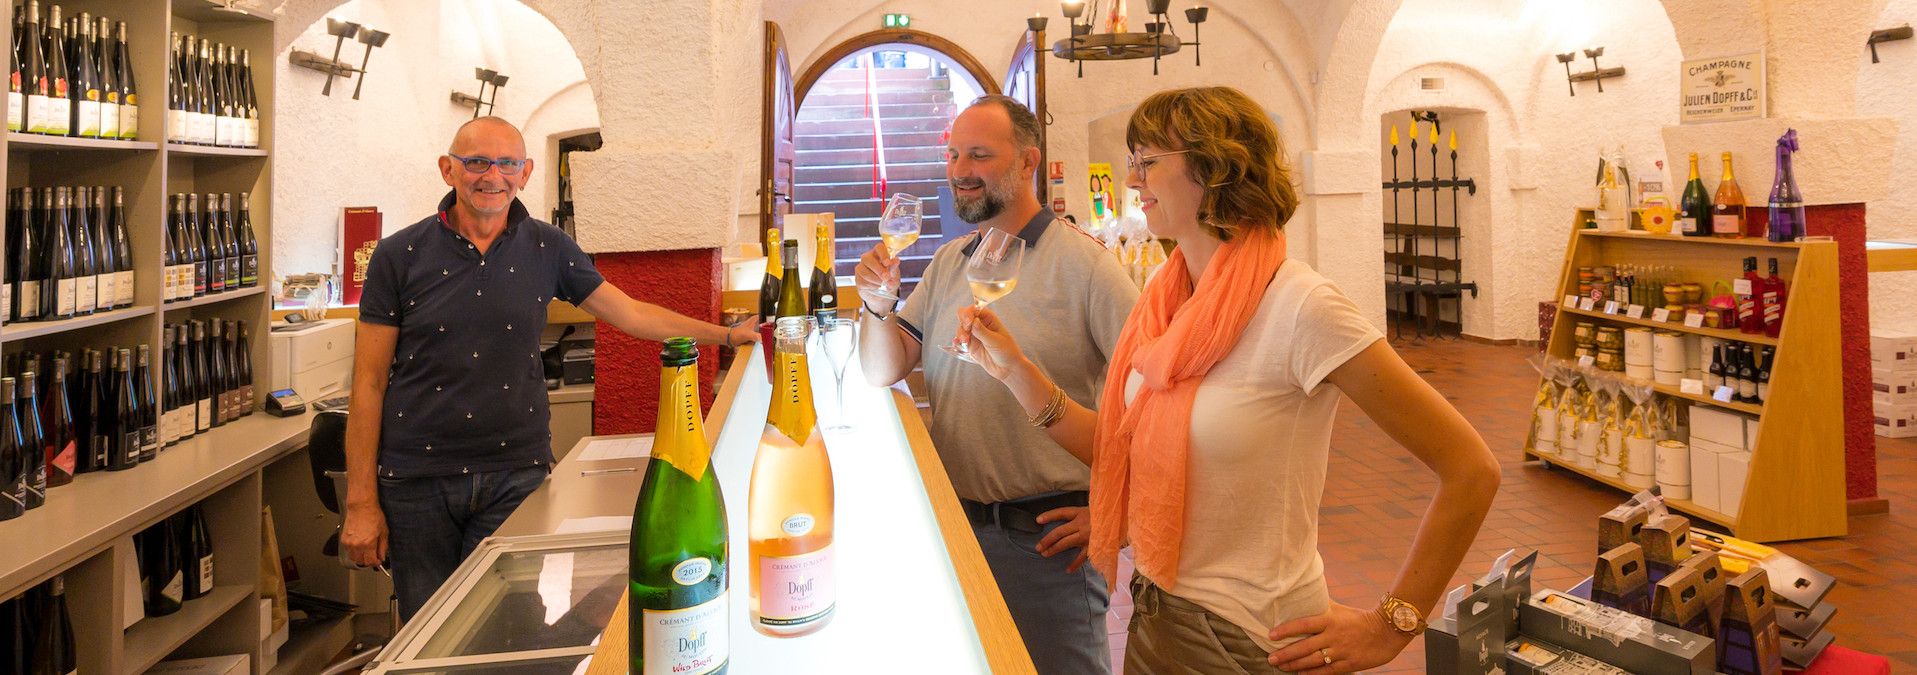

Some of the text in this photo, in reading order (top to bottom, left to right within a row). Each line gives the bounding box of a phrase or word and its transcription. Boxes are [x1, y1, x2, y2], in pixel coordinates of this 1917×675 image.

[1689, 60, 1752, 76] CHAMPAGNE
[1684, 94, 1711, 107] JULIEN
[1713, 91, 1739, 104] DOPFF
[790, 357, 799, 403] DOPFF
[685, 380, 695, 432] DOPFF
[789, 521, 807, 529] BRUT
[788, 578, 814, 596] Dopff
[679, 631, 708, 652] Dopff
